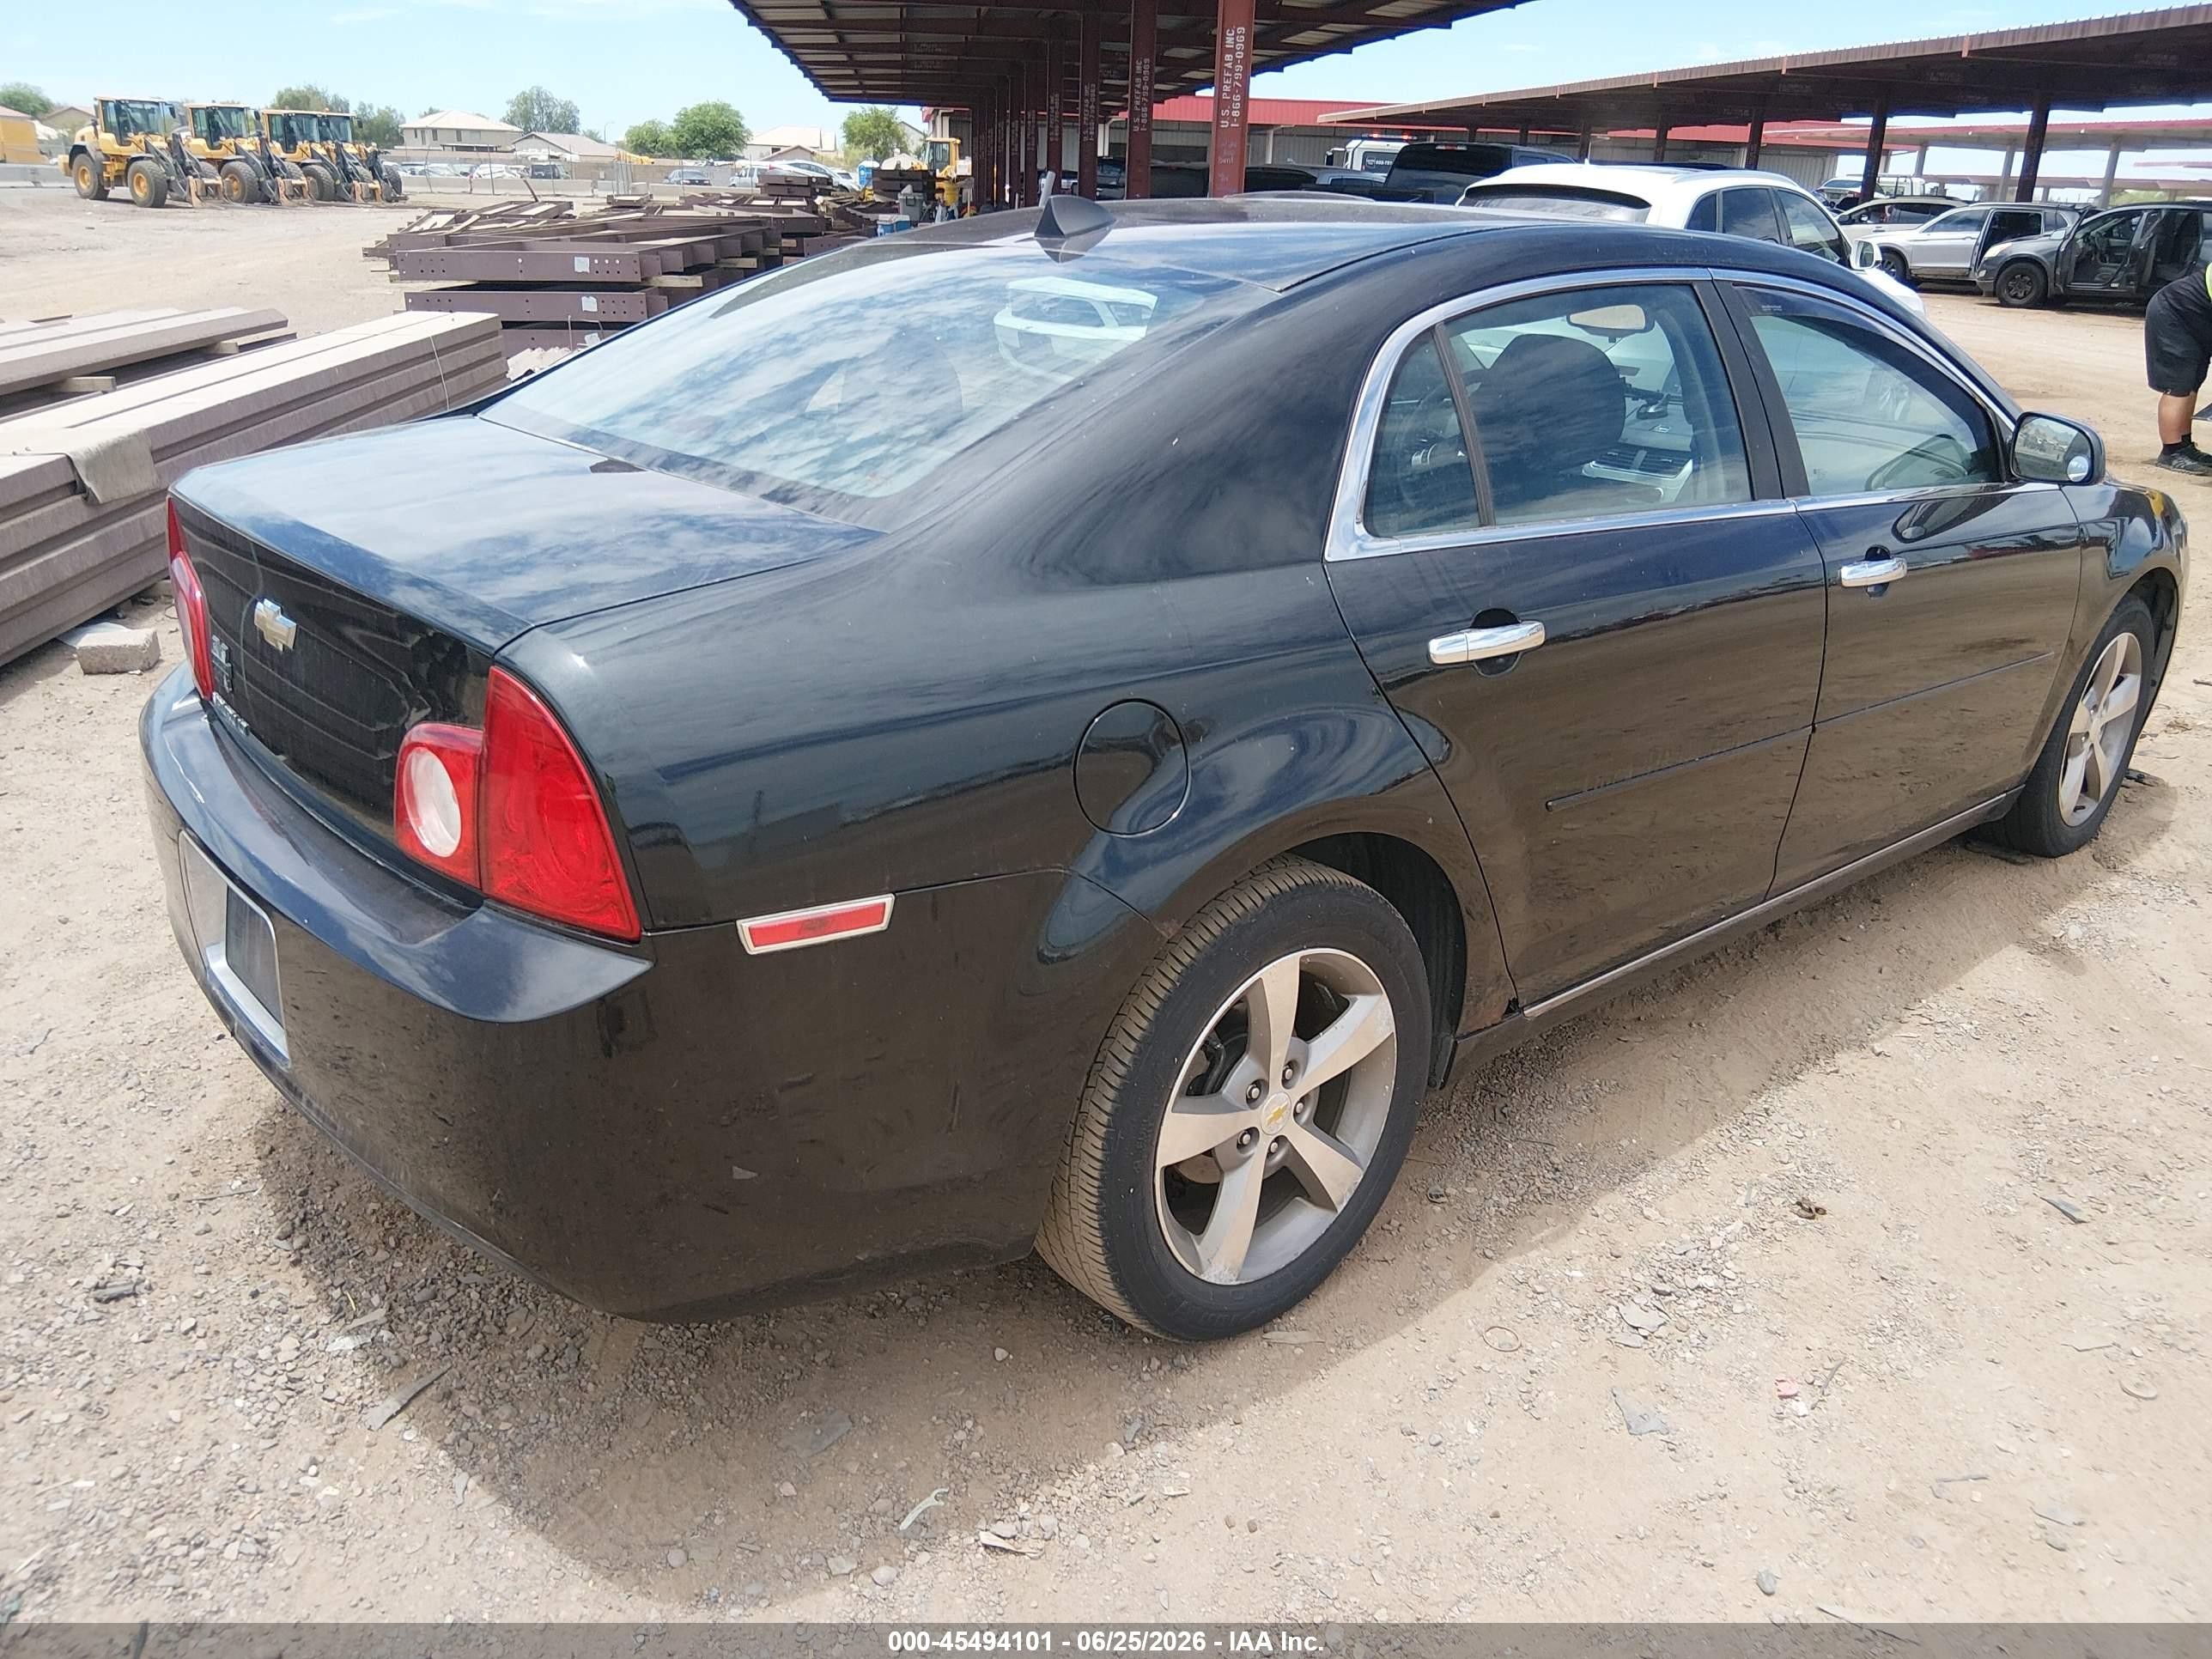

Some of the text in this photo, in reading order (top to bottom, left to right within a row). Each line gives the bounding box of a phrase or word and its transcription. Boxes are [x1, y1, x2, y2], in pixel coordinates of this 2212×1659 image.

[1224, 26, 1236, 48] INC.
[1222, 53, 1233, 100] PREFAB
[1231, 27, 1245, 127] 1-866-799-0969
[1220, 106, 1231, 128] U.S.
